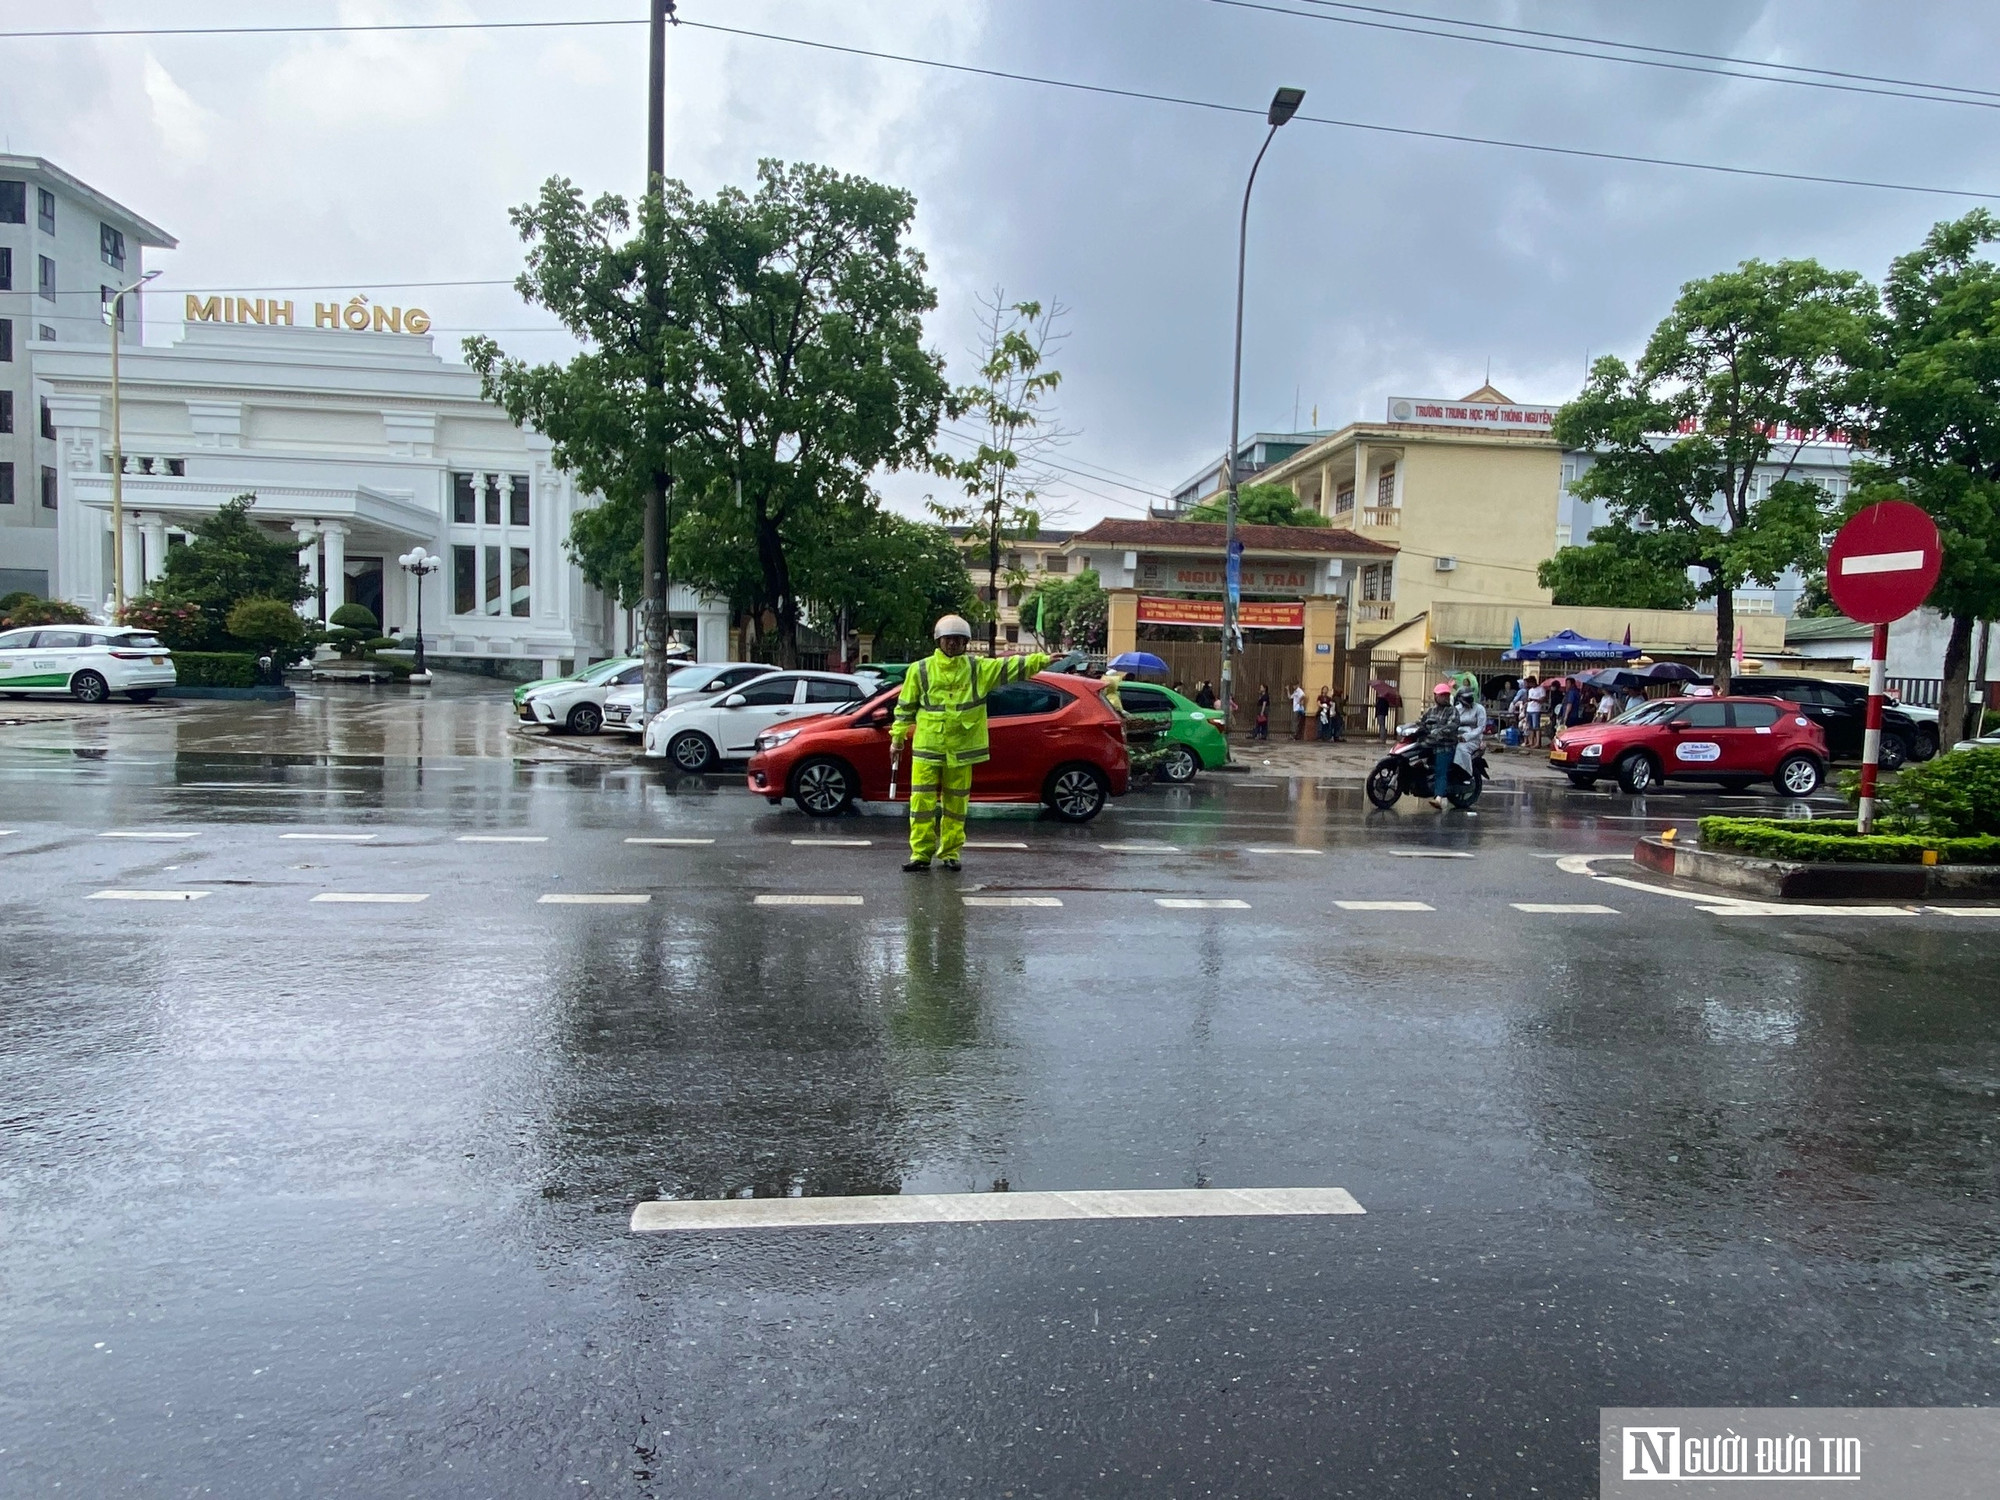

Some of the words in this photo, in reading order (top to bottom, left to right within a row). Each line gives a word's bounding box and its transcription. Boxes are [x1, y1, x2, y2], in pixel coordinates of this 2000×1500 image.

[186, 294, 294, 326] MINH
[315, 293, 431, 335] HỒNG
[1415, 404, 1442, 418] TRƯỜNG
[1445, 407, 1467, 419] TRUNG
[1468, 408, 1484, 422] HỌC
[1484, 406, 1500, 421] PHỔ
[1501, 409, 1522, 423] THÔNG
[1178, 570, 1254, 585] NGUYN
